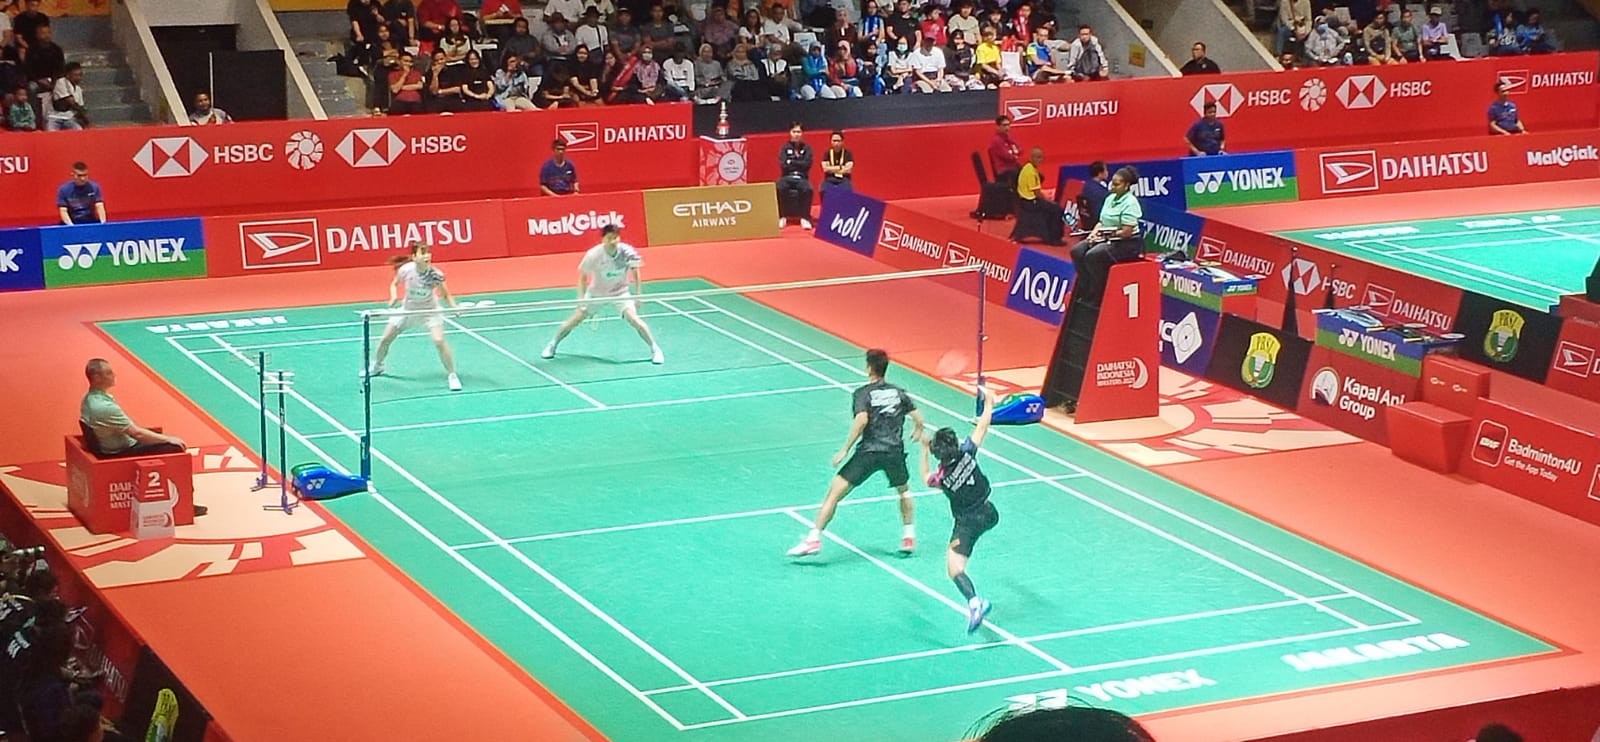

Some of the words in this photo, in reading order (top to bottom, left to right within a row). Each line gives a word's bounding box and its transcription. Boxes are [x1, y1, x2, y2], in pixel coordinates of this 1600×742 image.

[1391, 81, 1432, 97] HSBC
[1531, 72, 1594, 87] DAIHATSU
[1046, 101, 1119, 118] DAIHATSU
[1248, 89, 1291, 106] HSBC
[411, 135, 467, 154] HSBC
[604, 124, 687, 143] DAIHATSU
[214, 143, 274, 164] HSBC
[1382, 152, 1488, 181] DAIHATSU
[1229, 167, 1286, 191] YONEX
[673, 200, 752, 217] ETIHAD
[692, 216, 737, 228] AIRWAYS
[326, 219, 473, 253] DAIHATSU
[901, 233, 944, 260] DAIHATSU
[1155, 224, 1193, 254] YONEX
[106, 237, 187, 266] YONEX
[1223, 249, 1275, 276] DAIHATSU
[1010, 266, 1069, 312] AQU
[1173, 274, 1202, 298] YONEX
[1321, 276, 1356, 299] HSBC
[1123, 282, 1141, 319] 1
[1392, 299, 1452, 331] DAIHATSU
[1360, 333, 1396, 361] YONEX
[1343, 377, 1379, 402] Kapal
[1339, 396, 1376, 420] Group
[1508, 438, 1582, 475] Badminton4U
[148, 472, 160, 487] 2
[1073, 668, 1218, 701] YONEX
